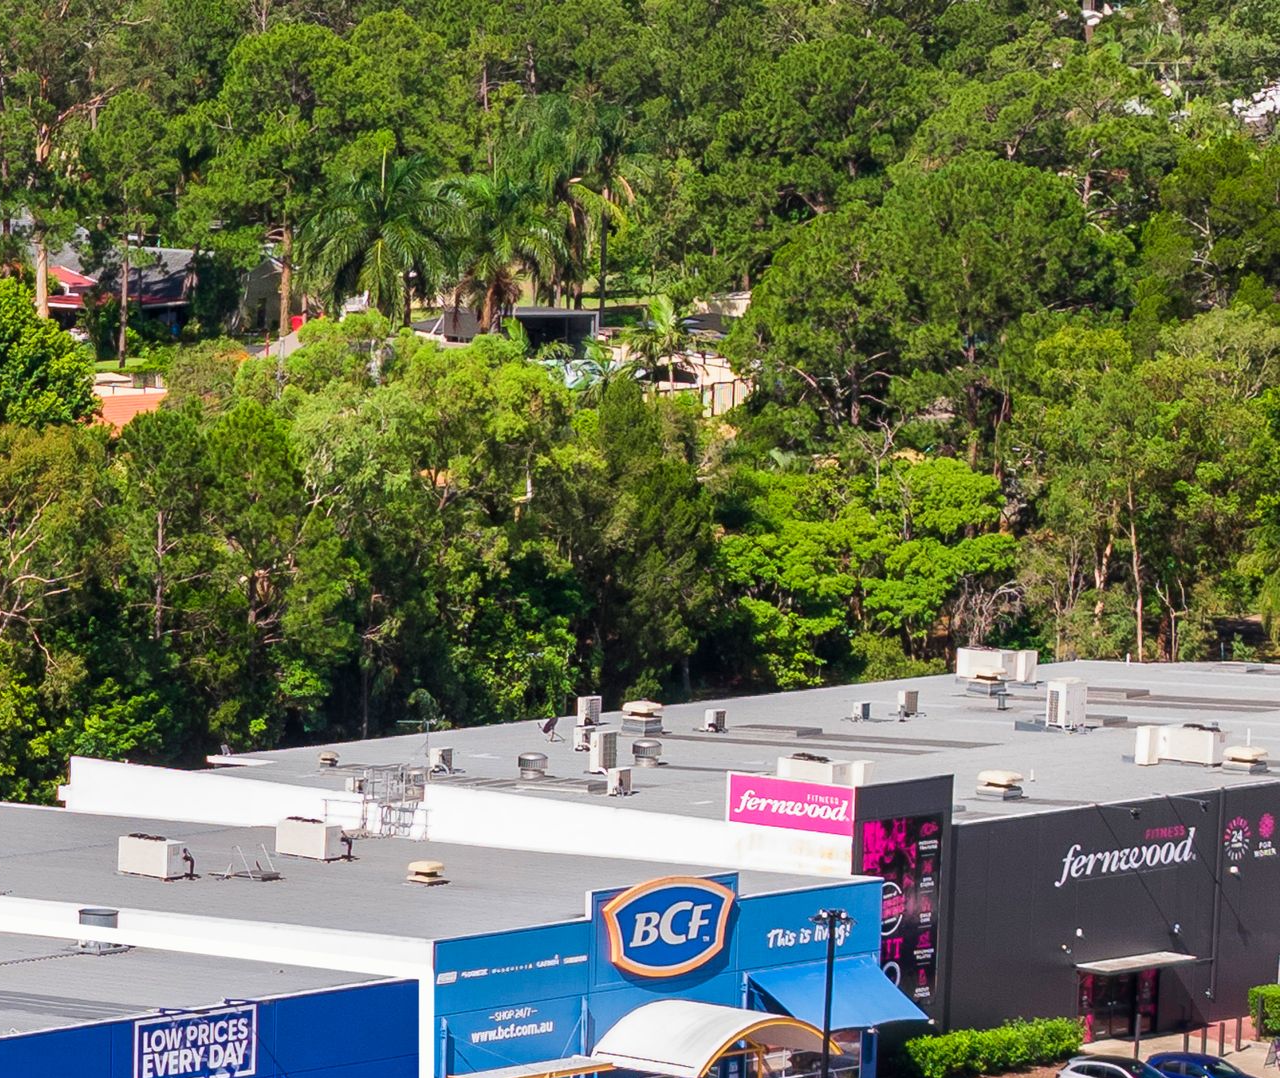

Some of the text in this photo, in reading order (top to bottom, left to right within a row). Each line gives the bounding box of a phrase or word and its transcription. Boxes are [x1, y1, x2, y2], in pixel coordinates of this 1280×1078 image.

[733, 789, 849, 822] fernwood
[1144, 824, 1186, 841] FITNESS
[1054, 826, 1196, 888] fernwood
[628, 900, 713, 949] BCF
[766, 927, 796, 949] This
[799, 926, 811, 945] is
[142, 1017, 249, 1054] LOW PRICES
[470, 1020, 554, 1044] www.bcf.com.au
[206, 1039, 248, 1070] DAY
